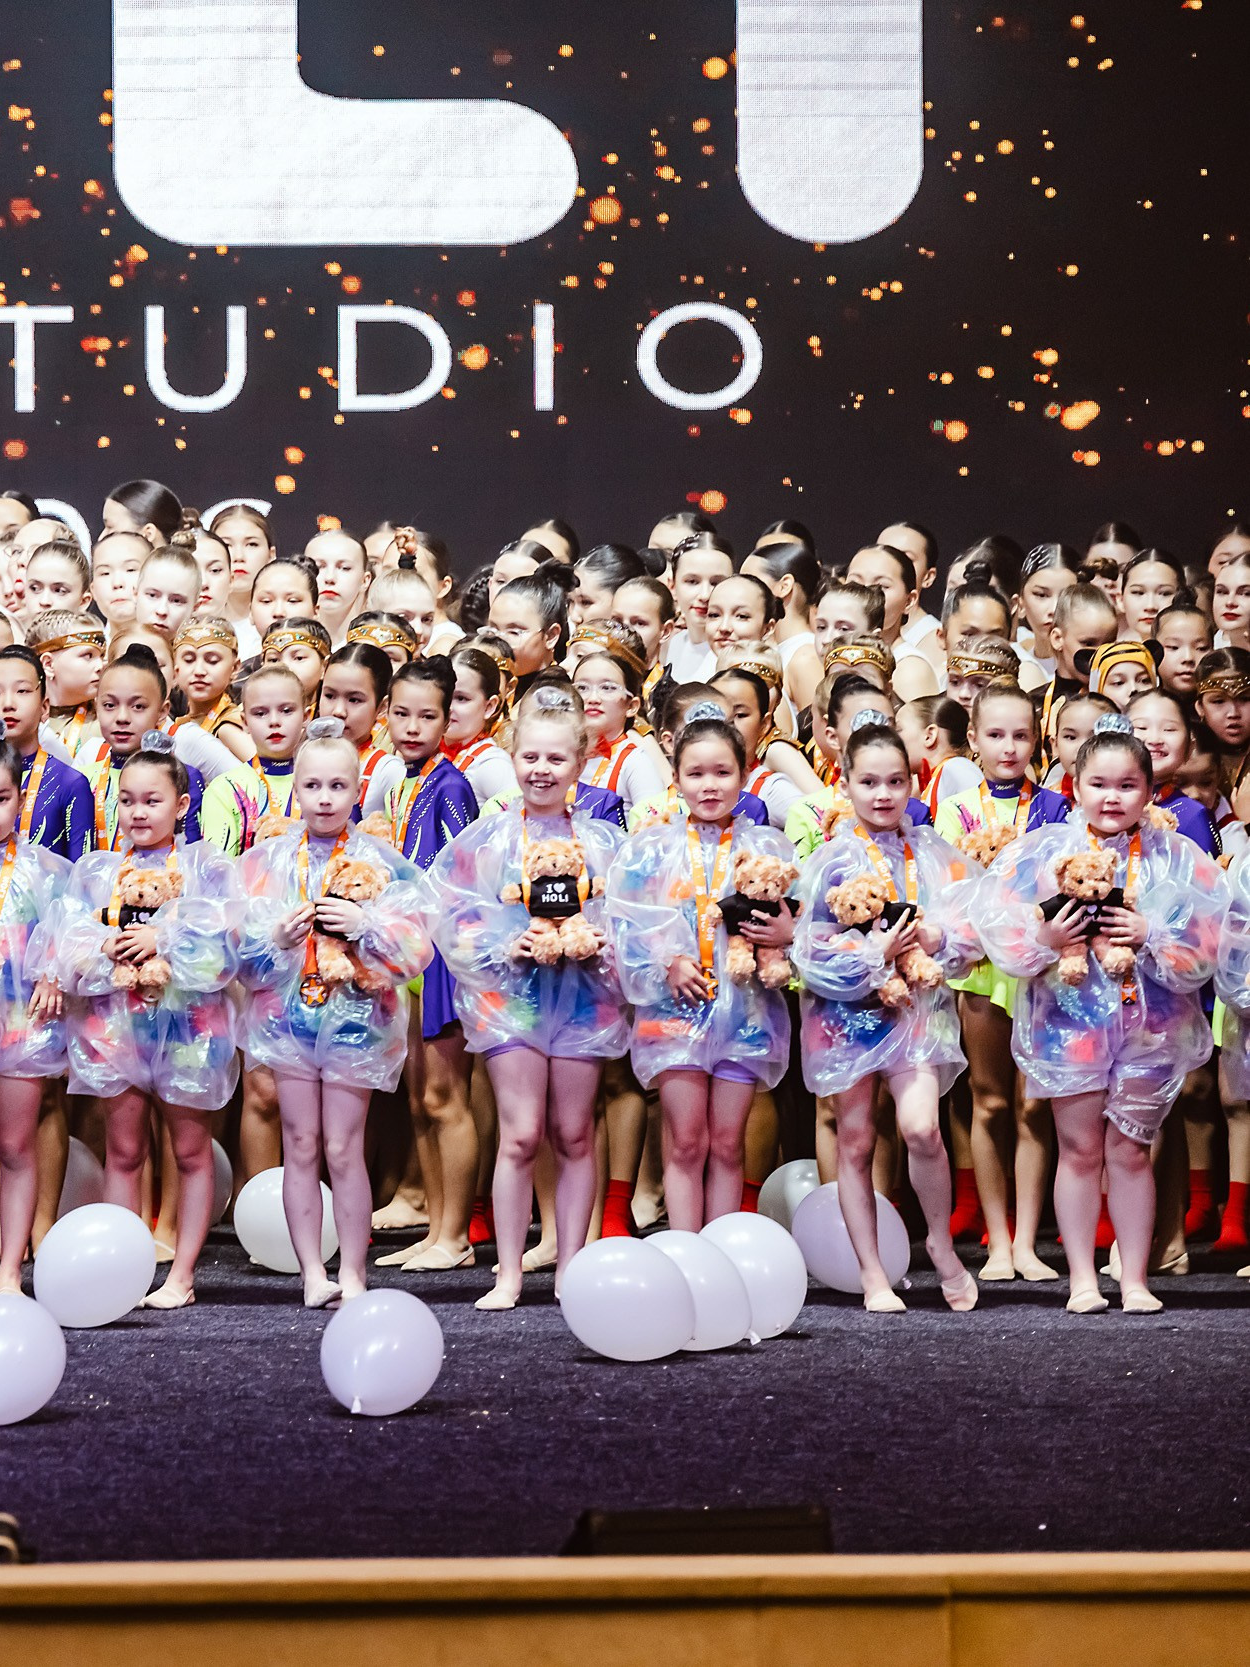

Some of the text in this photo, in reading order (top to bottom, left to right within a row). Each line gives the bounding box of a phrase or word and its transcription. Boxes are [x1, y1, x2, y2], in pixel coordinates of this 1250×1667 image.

[546, 883, 553, 893] I
[541, 893, 569, 903] HOLI
[132, 912, 137, 922] I
